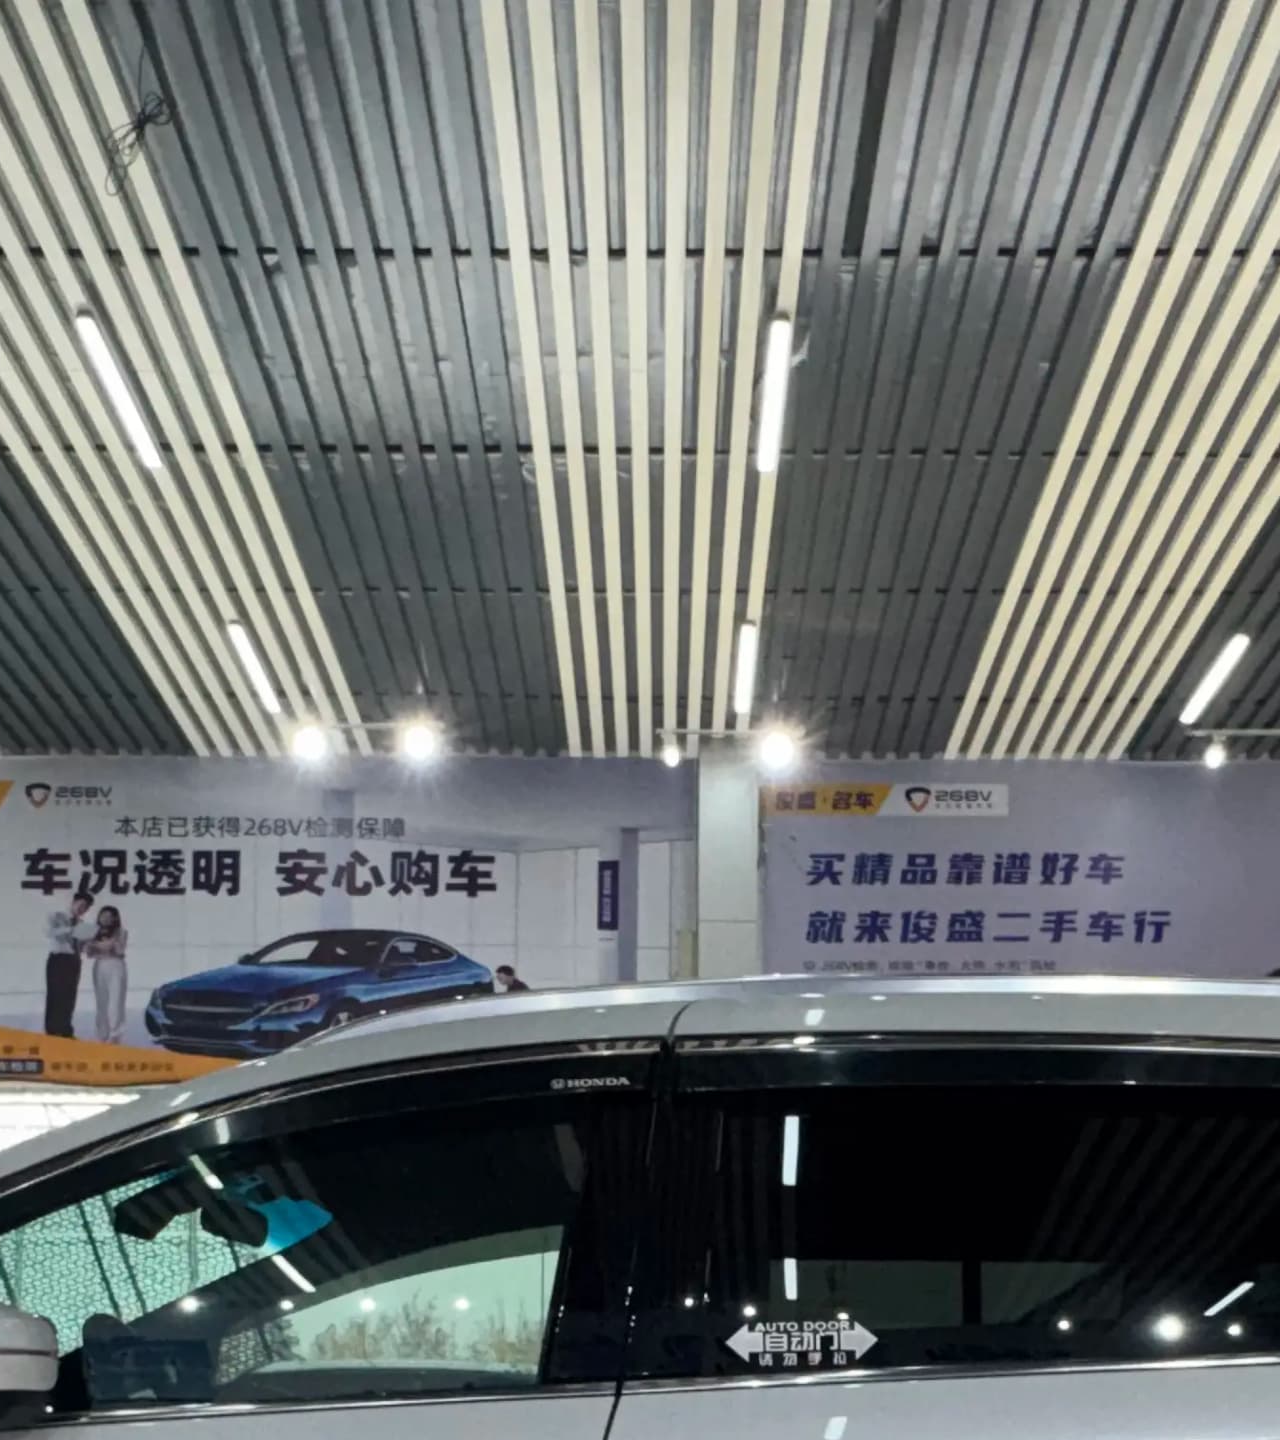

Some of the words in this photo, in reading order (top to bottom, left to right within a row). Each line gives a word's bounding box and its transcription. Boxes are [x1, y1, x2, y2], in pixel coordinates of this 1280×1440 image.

[55, 786, 113, 798] 268V
[934, 790, 993, 802] 268V
[114, 816, 406, 838] 本店已获得268V检测保障
[21, 848, 241, 896] 车况透明
[276, 849, 497, 897] 安心购车
[805, 852, 1126, 886] 买精品靠谱好车
[804, 910, 1172, 944] 就来俊盛二手车行
[567, 1077, 631, 1088] HONDA
[754, 1322, 799, 1332] AUTO
[803, 1321, 850, 1331] DOOR
[765, 1331, 839, 1352] 自动门
